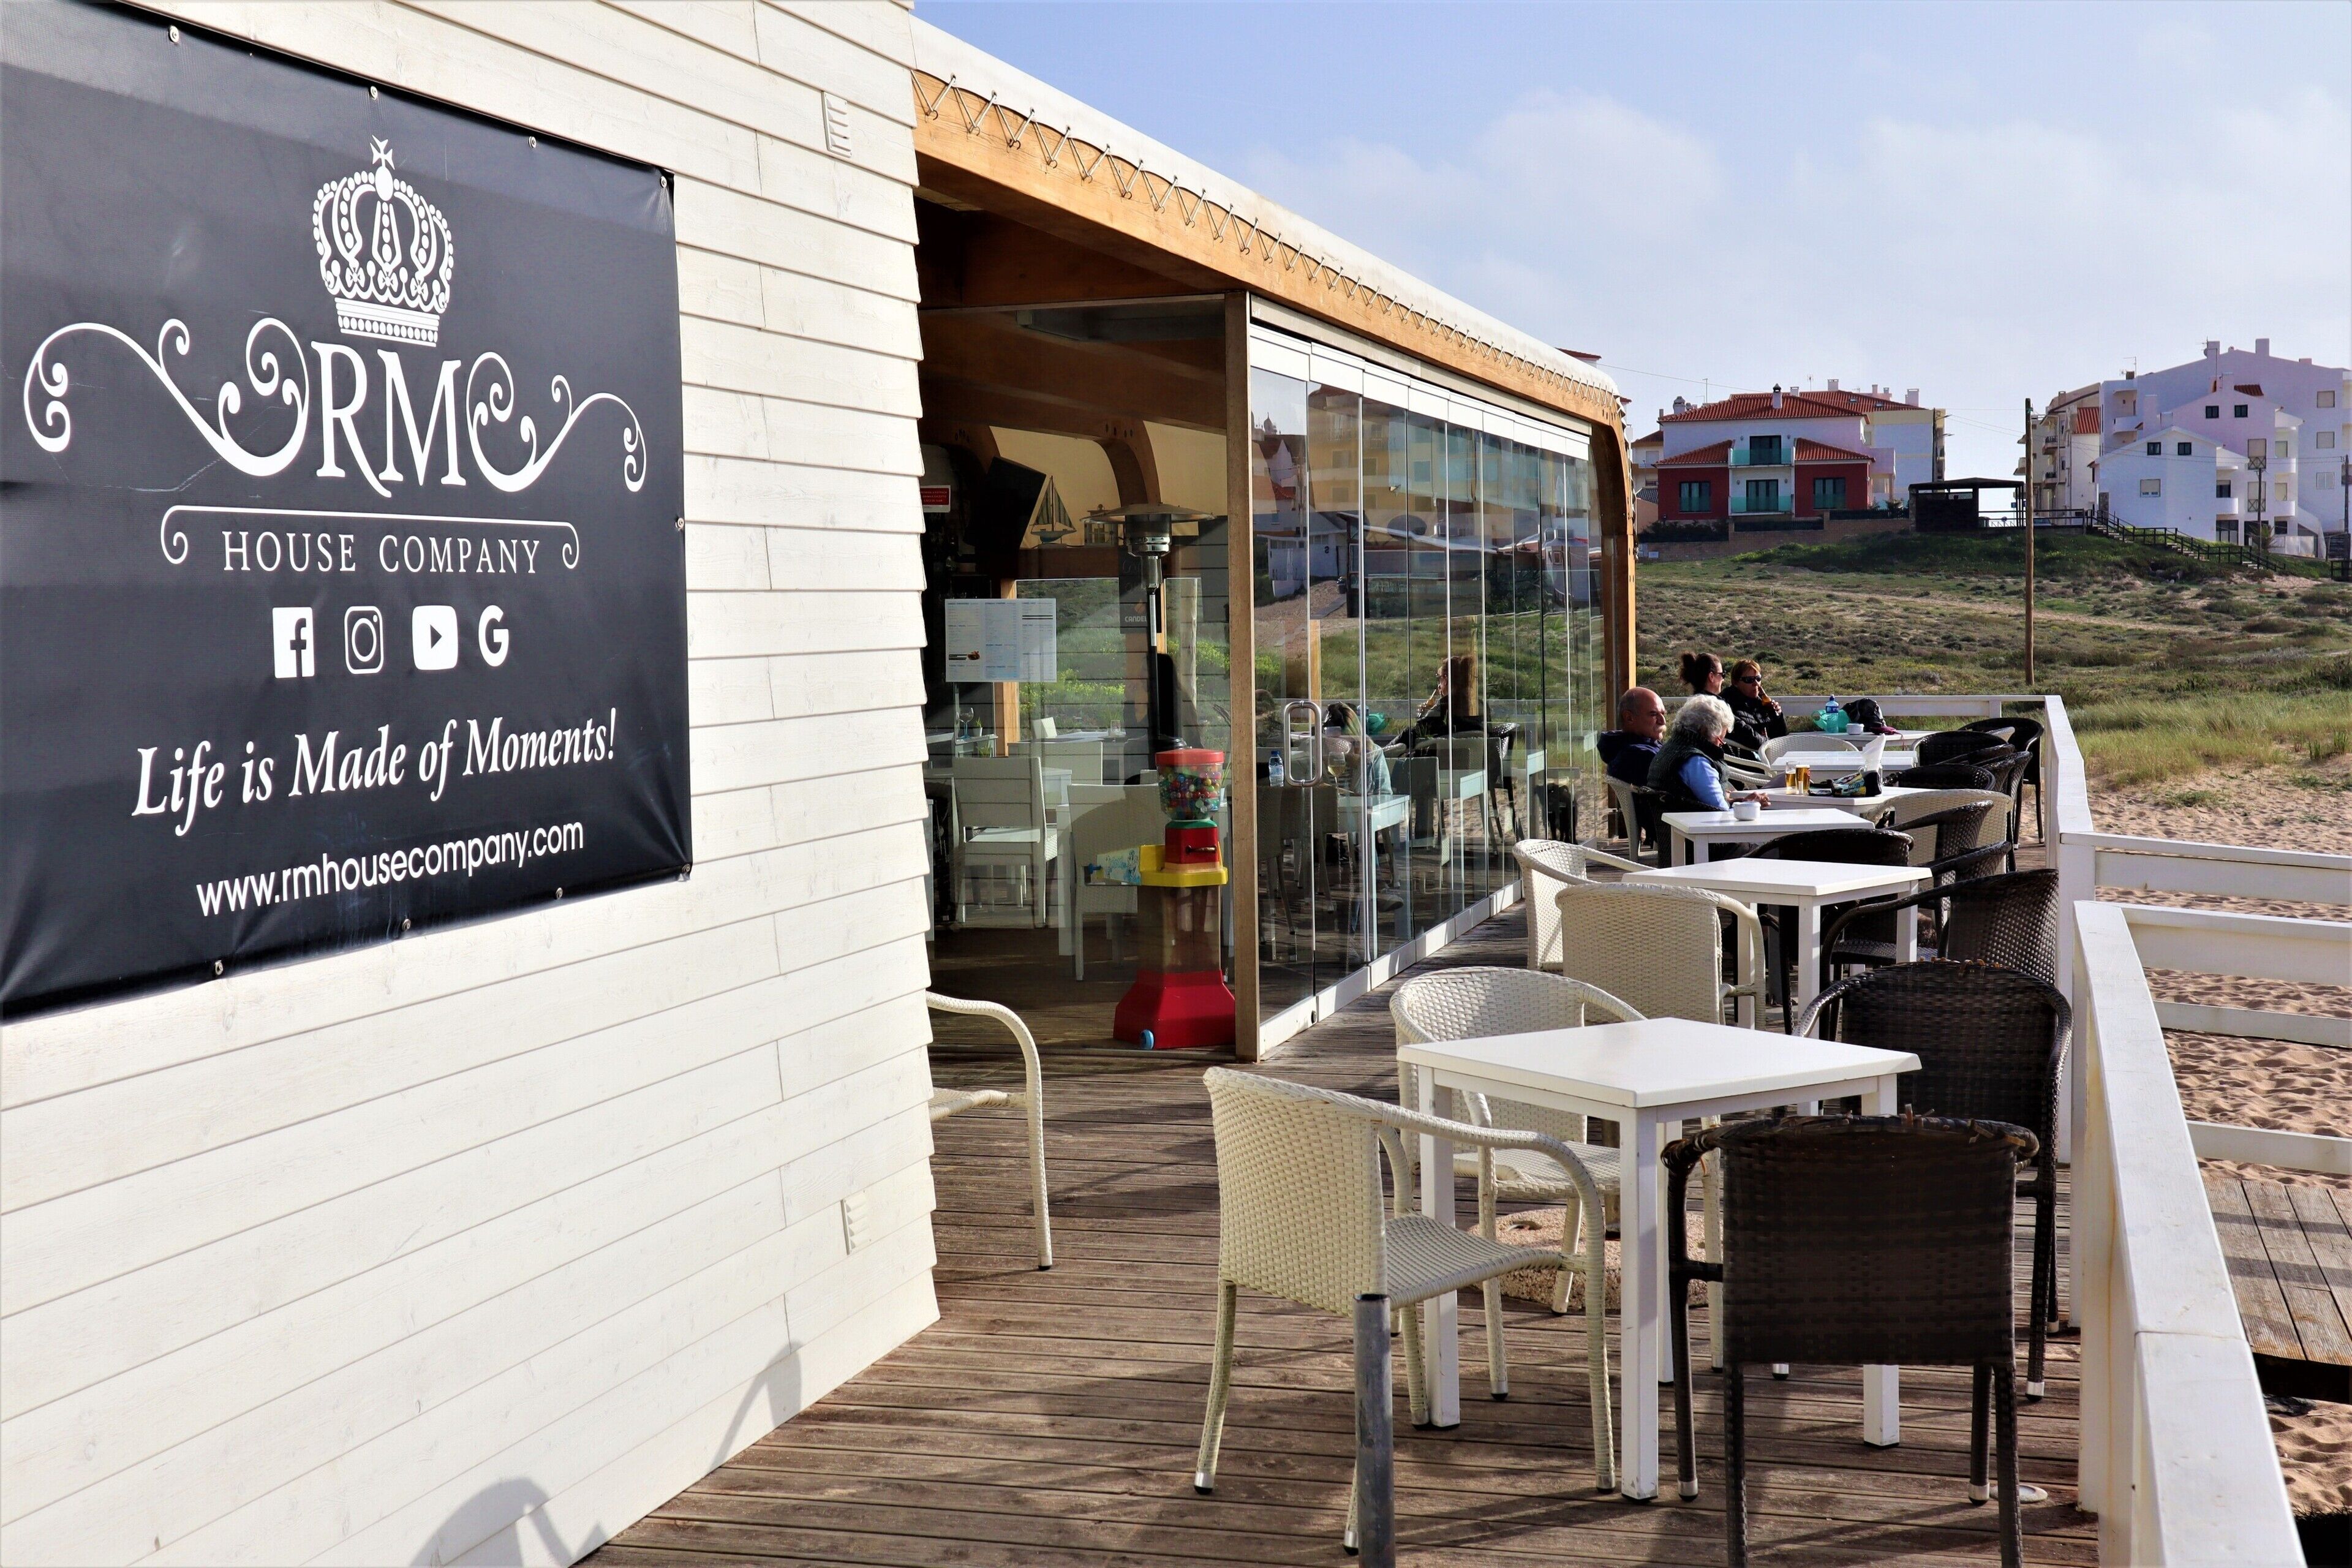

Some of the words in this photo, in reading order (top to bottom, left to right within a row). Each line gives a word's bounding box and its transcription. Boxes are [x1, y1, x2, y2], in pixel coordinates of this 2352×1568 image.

[222, 530, 356, 572] HOUSE
[379, 535, 540, 574] COMPANY
[131, 740, 225, 837] Life
[241, 741, 274, 804] is
[288, 724, 407, 797] Made
[418, 718, 458, 802] of
[462, 707, 616, 776] Moments!
[196, 821, 583, 917] www.rmhousecompany.com
